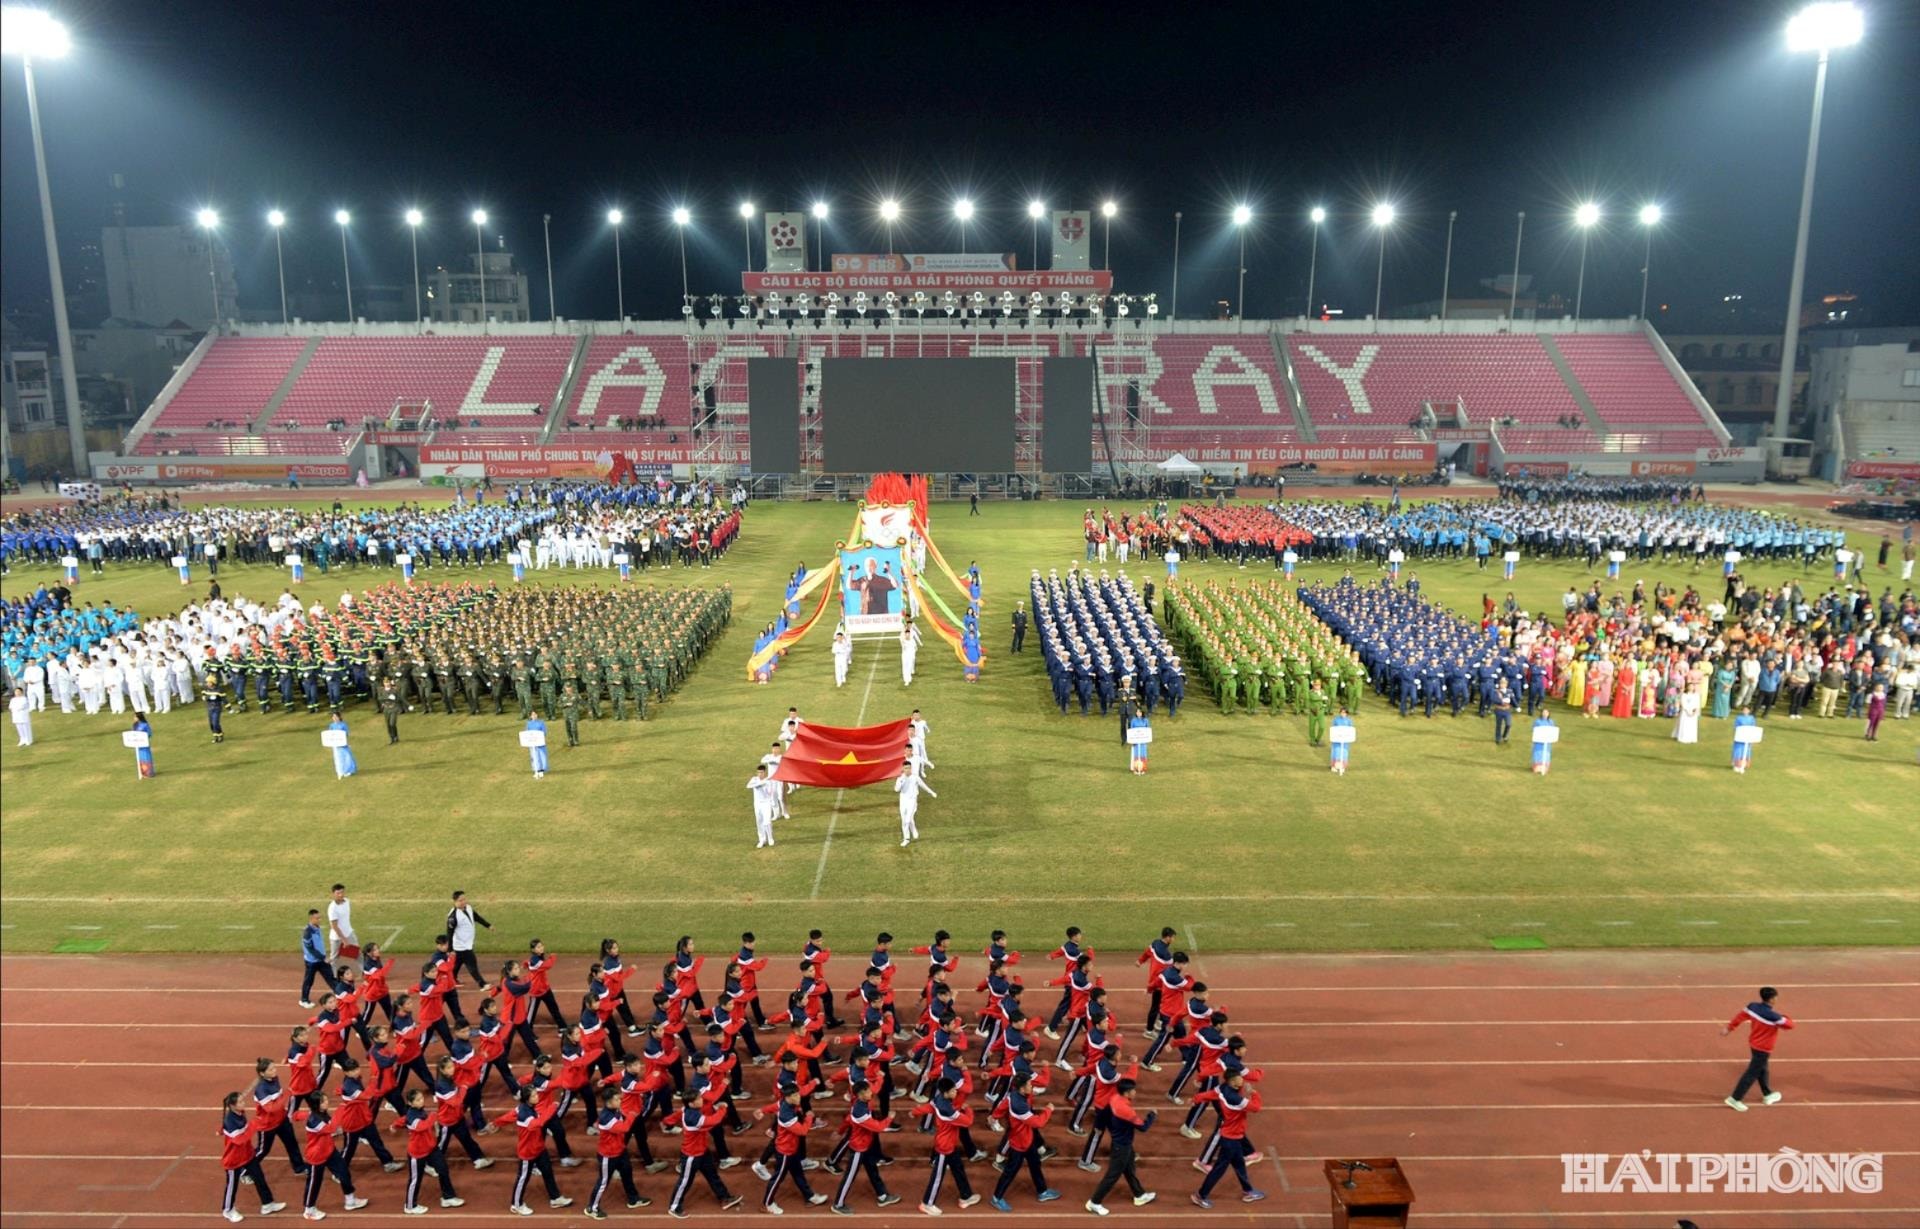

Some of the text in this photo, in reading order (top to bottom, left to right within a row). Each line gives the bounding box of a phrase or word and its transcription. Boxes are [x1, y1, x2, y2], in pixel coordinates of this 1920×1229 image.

[761, 272, 1095, 289] CÂU LẠC BỘ BÓNG ĐÁ HẢI PHÒNG QUYẾT THẮNG
[430, 447, 459, 462] NHÂN
[461, 447, 483, 462] DÂN
[485, 447, 519, 462] THÀNH
[521, 447, 542, 462] PHỐ
[544, 450, 579, 462] CHUNG
[581, 450, 598, 461] TAY
[657, 447, 684, 461] PHÁT
[1234, 449, 1252, 460] TIN
[1255, 447, 1276, 460] YÊU
[1279, 446, 1302, 460] CỦA
[1304, 446, 1339, 460] NGƯỜI
[1342, 447, 1365, 460] DÂN
[1392, 446, 1423, 460] CẢNG
[1722, 448, 1745, 458] VPF
[120, 466, 144, 475] VPF
[179, 466, 215, 478] FPT Play
[303, 465, 346, 477] Kappa
